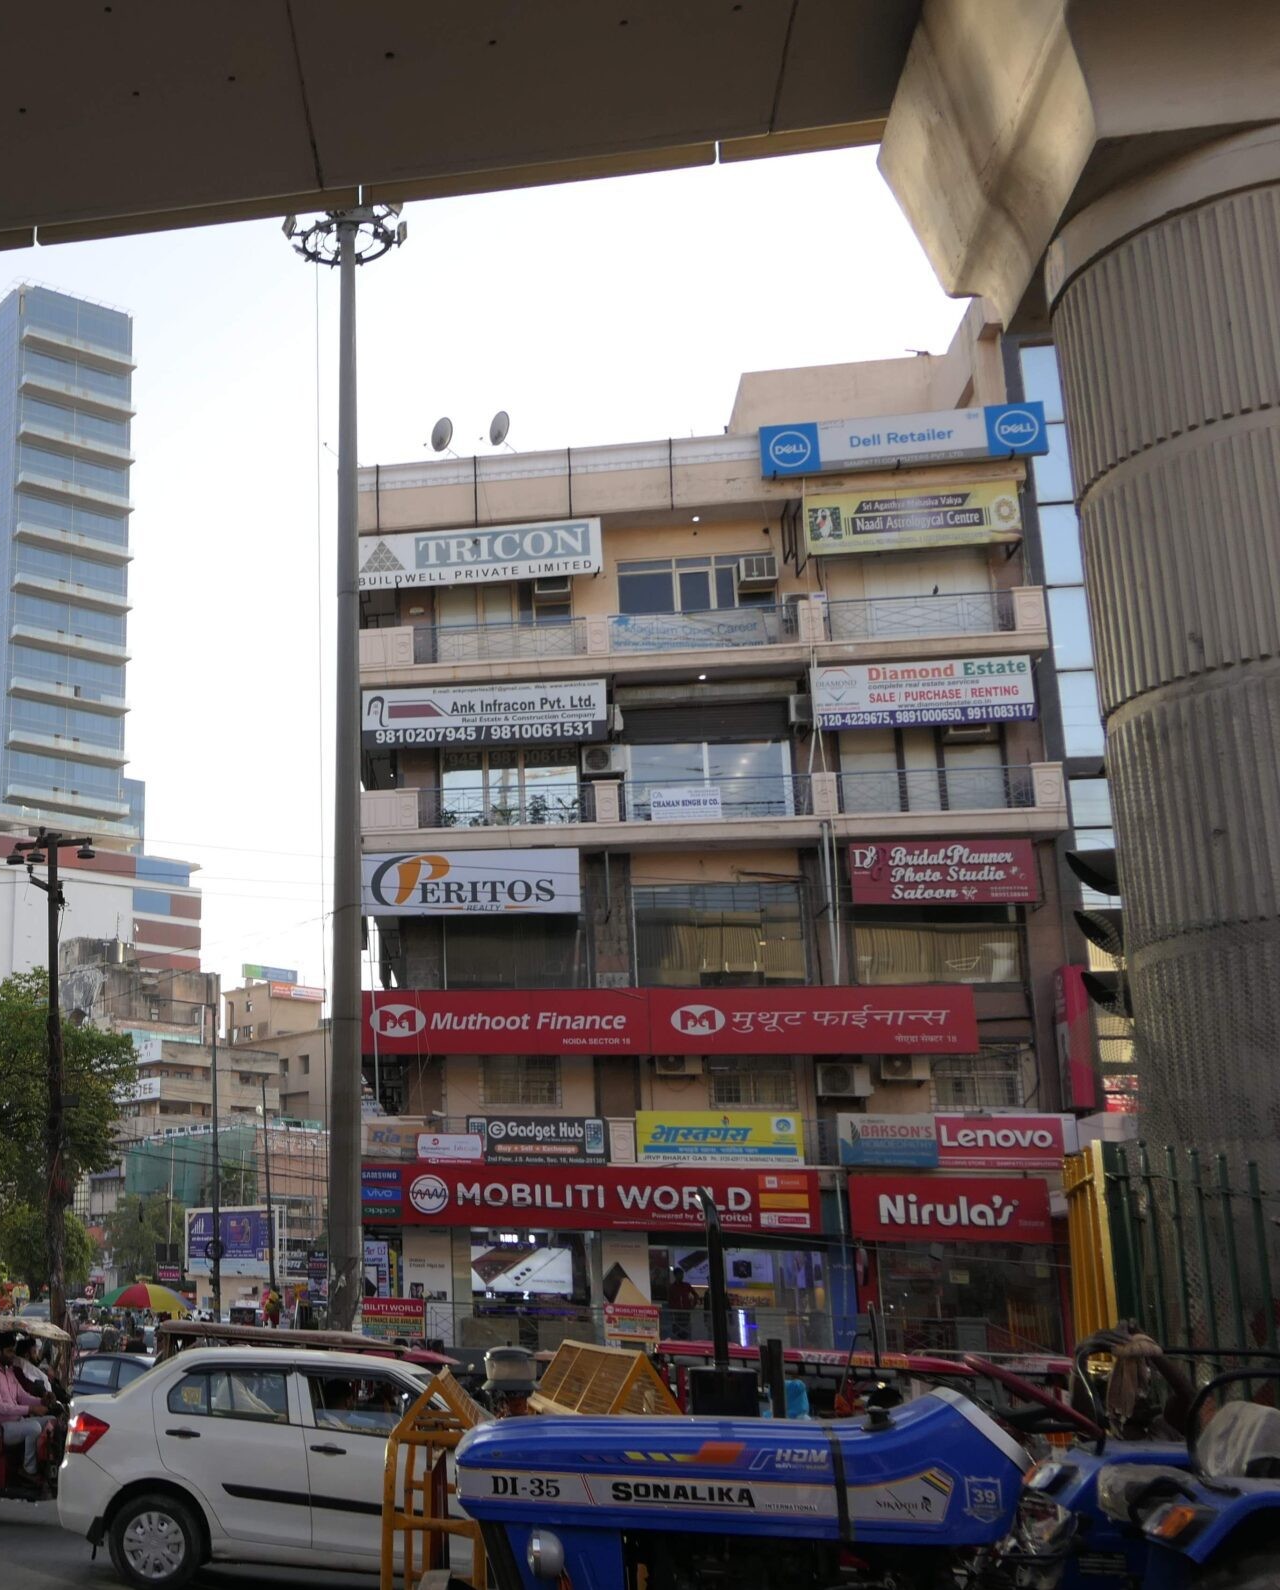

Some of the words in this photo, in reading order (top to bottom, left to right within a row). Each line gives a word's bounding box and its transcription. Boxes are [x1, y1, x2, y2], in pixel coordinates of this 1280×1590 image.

[849, 434, 881, 448] Dell
[887, 428, 954, 445] Retailer
[1001, 423, 1035, 435] DELL
[775, 444, 807, 455] DELL
[855, 516, 883, 531] Naadi
[886, 512, 944, 530] Astrologycal
[947, 510, 980, 524] Centre
[419, 527, 586, 565] TRICON
[359, 569, 447, 586] BUILDWELL
[454, 566, 520, 580] PRIVATE
[528, 560, 592, 574] LIMITED
[867, 663, 955, 681] Diamond
[963, 660, 1028, 676] Estate
[867, 682, 904, 690] complete
[922, 680, 946, 688] estate
[946, 679, 980, 687] services
[868, 692, 896, 704] SALE
[904, 688, 962, 701] PURCHASE
[970, 685, 1020, 698] RENTING
[450, 700, 477, 714] Ank
[480, 698, 536, 713] Infracon
[540, 696, 566, 711] Pvt.
[570, 695, 597, 709] Ltd.
[967, 704, 1035, 720] 9911083117
[461, 716, 478, 724] Real
[479, 715, 503, 723] Estate
[511, 713, 560, 722] Construction
[561, 711, 596, 721] Company
[375, 728, 477, 745] 9810207945
[480, 726, 487, 741] /
[490, 722, 594, 740] 9810061531
[888, 846, 947, 866] Bridal
[946, 844, 1014, 866] Planner
[394, 854, 556, 905] PERITOS
[890, 866, 943, 883] Photo
[946, 865, 1007, 882] Studio
[890, 884, 960, 900] Saloon
[466, 904, 502, 912] REALTY
[430, 1011, 531, 1031] Muthoot
[536, 1012, 627, 1031] Finance
[731, 1010, 806, 1034] मुथूट
[562, 1038, 587, 1046] NOIDA
[588, 1038, 620, 1046] SECTOR
[507, 1121, 556, 1141] Gadget
[558, 1120, 585, 1138] Hub
[860, 1124, 933, 1138] BAKSON'S
[940, 1124, 1054, 1148] Lenovo
[361, 1171, 397, 1180] SAMSUNG
[366, 1188, 393, 1199] vivo
[456, 1182, 605, 1209] MOBILITI
[616, 1184, 752, 1212] WORLD
[364, 1207, 396, 1216] oppo
[878, 1193, 1014, 1227] Nirula's
[389, 1304, 423, 1312] WORLD
[775, 1448, 828, 1464] HDM
[491, 1475, 561, 1498] DI-35
[611, 1481, 756, 1507] SONALIKA
[973, 1488, 997, 1504] 39
[764, 1503, 819, 1512] INTERNATIONAL
